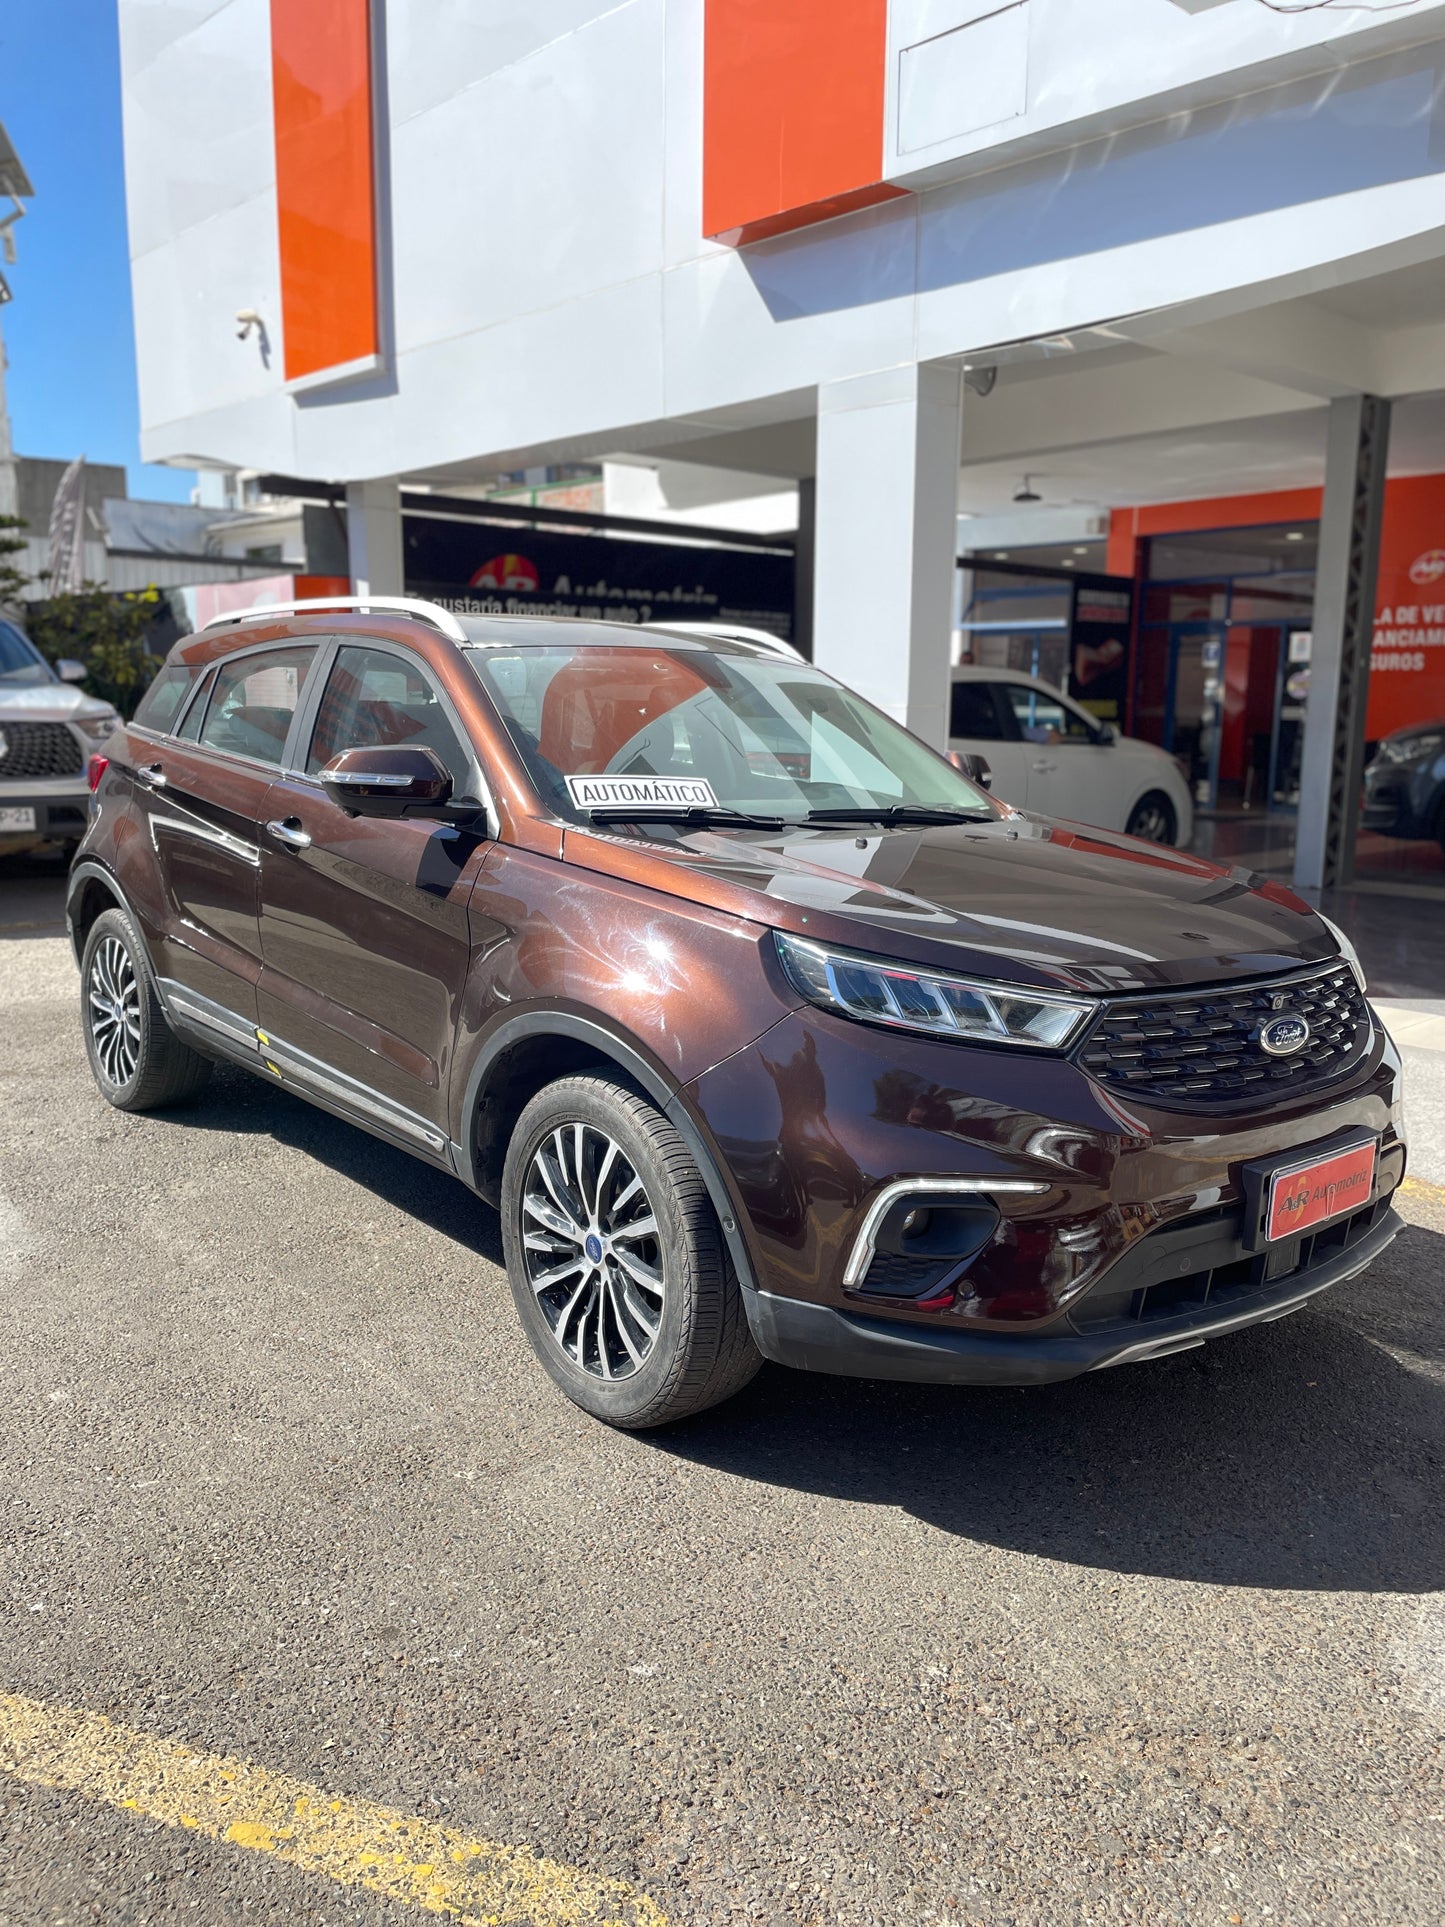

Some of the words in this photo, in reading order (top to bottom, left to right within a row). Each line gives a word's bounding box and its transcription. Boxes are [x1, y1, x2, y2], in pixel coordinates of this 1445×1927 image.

[506, 597, 577, 617] financiar
[1395, 605, 1419, 625] DE
[583, 781, 708, 803] AUTOMÁTICO
[1273, 1023, 1303, 1046] Ford
[1311, 1168, 1368, 1202] Automotriz
